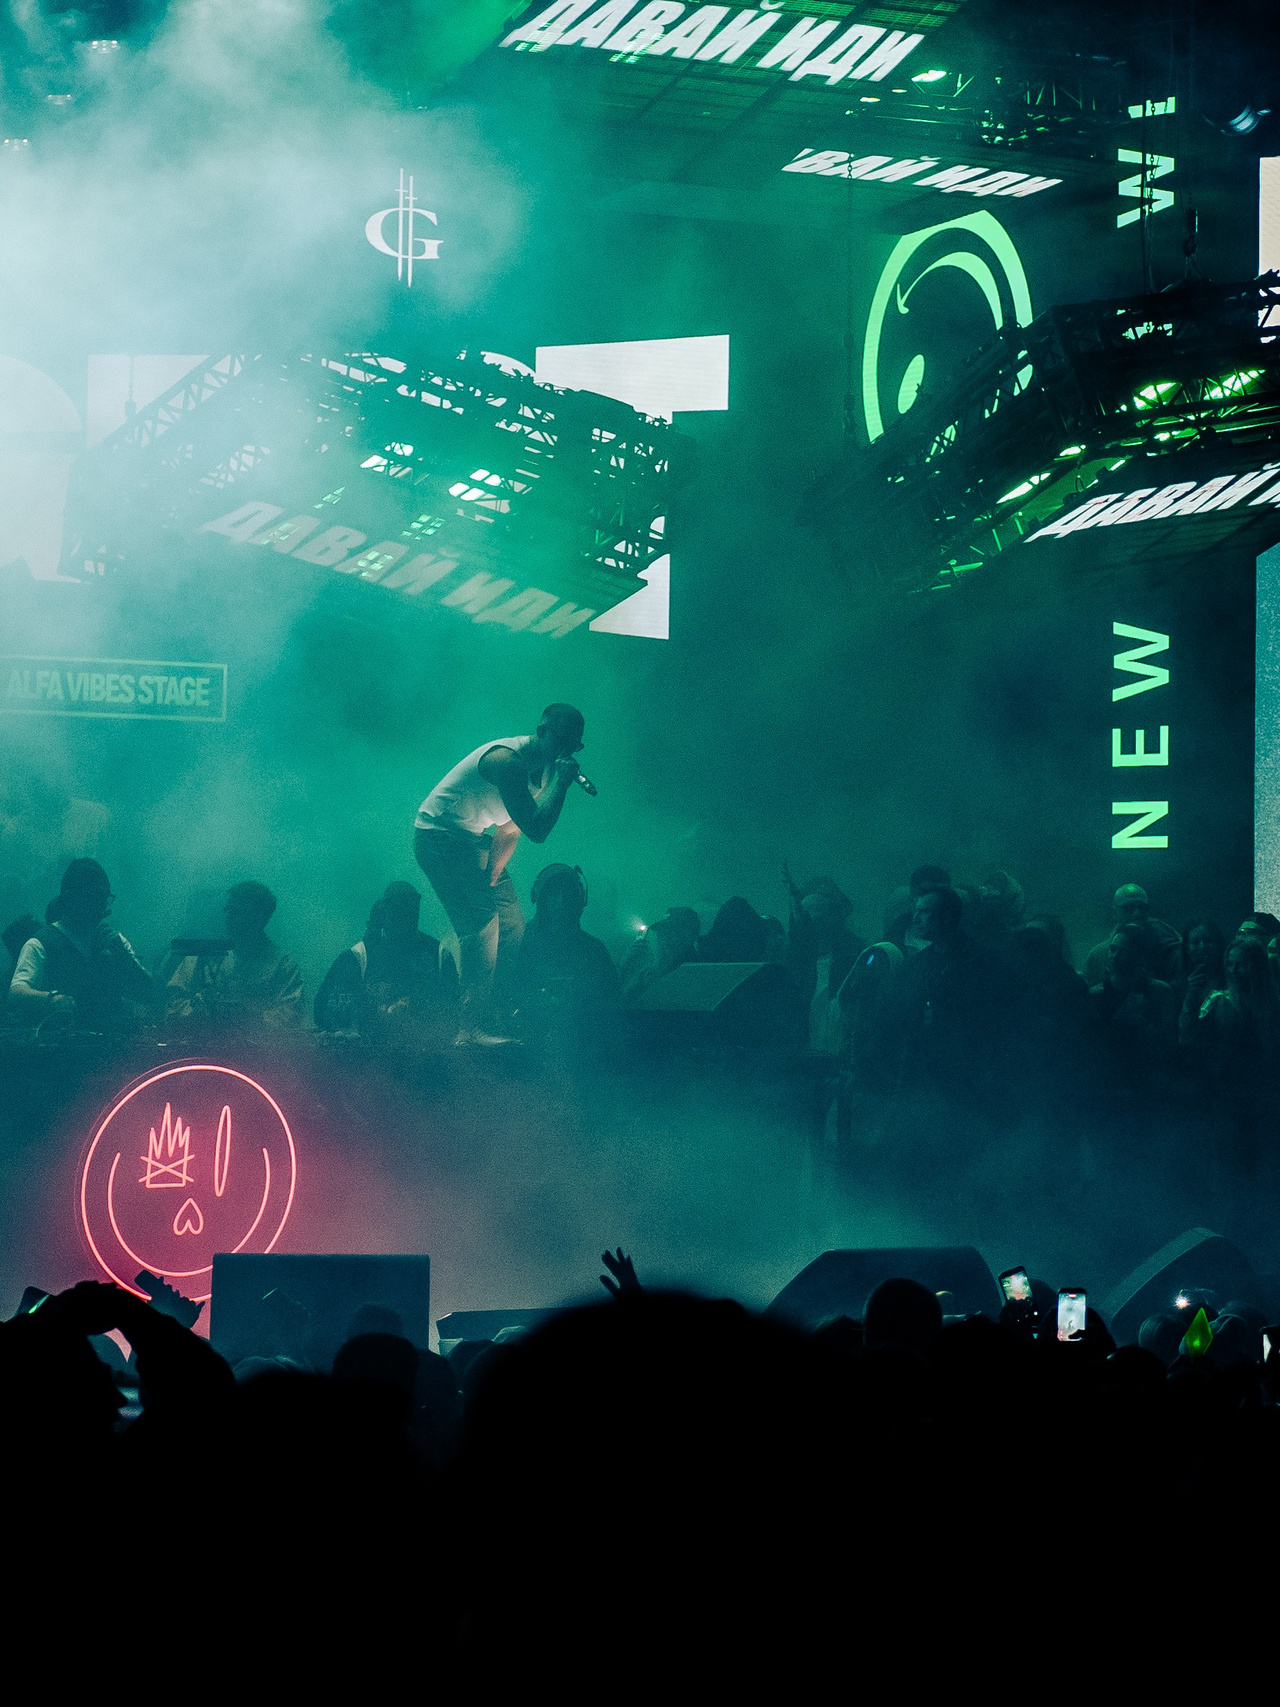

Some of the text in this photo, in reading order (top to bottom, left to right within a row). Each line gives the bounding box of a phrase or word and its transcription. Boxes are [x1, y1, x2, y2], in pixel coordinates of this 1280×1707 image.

[498, 0, 925, 86] ДАВАЙ ИДИ
[911, 165, 1064, 198] ИДИ
[1023, 462, 1280, 544] ДАВАЙ
[195, 501, 596, 640] ДАВАЙ ИДИ
[7, 667, 211, 707] ALFA VIBES STAGE
[1112, 621, 1170, 849] NEW
